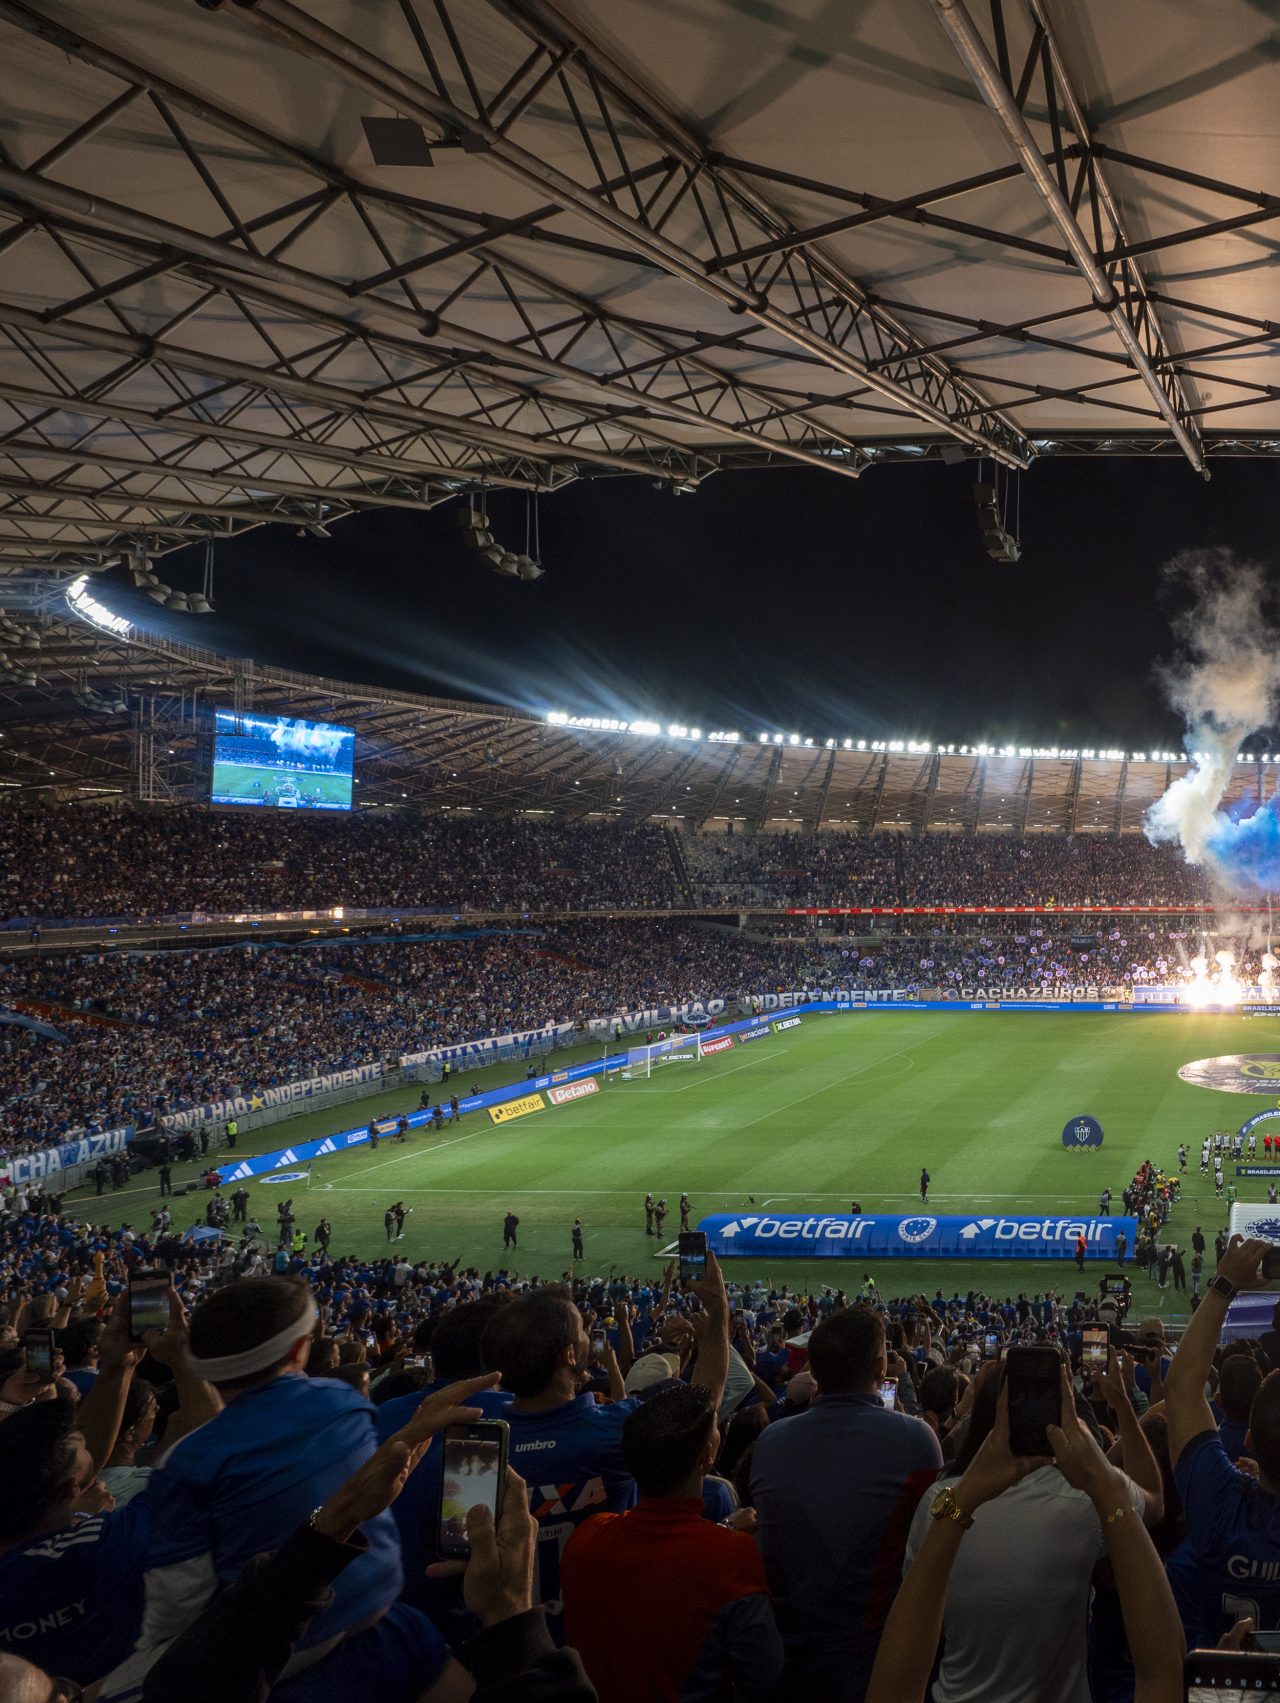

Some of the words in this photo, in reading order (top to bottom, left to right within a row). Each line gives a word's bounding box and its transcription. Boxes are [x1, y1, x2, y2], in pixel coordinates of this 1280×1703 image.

[961, 987, 1099, 999] CACHAZEIROS
[738, 1025, 771, 1042] betnacional
[702, 1037, 732, 1053] SUPERBET
[263, 1062, 382, 1106] INDEPENDENTE
[555, 1082, 596, 1101] Betano
[505, 1099, 543, 1117] betfair
[77, 1128, 128, 1163] AZUL
[754, 1217, 876, 1239] betfair
[994, 1218, 1113, 1241] betfair
[514, 1440, 557, 1453] umbro
